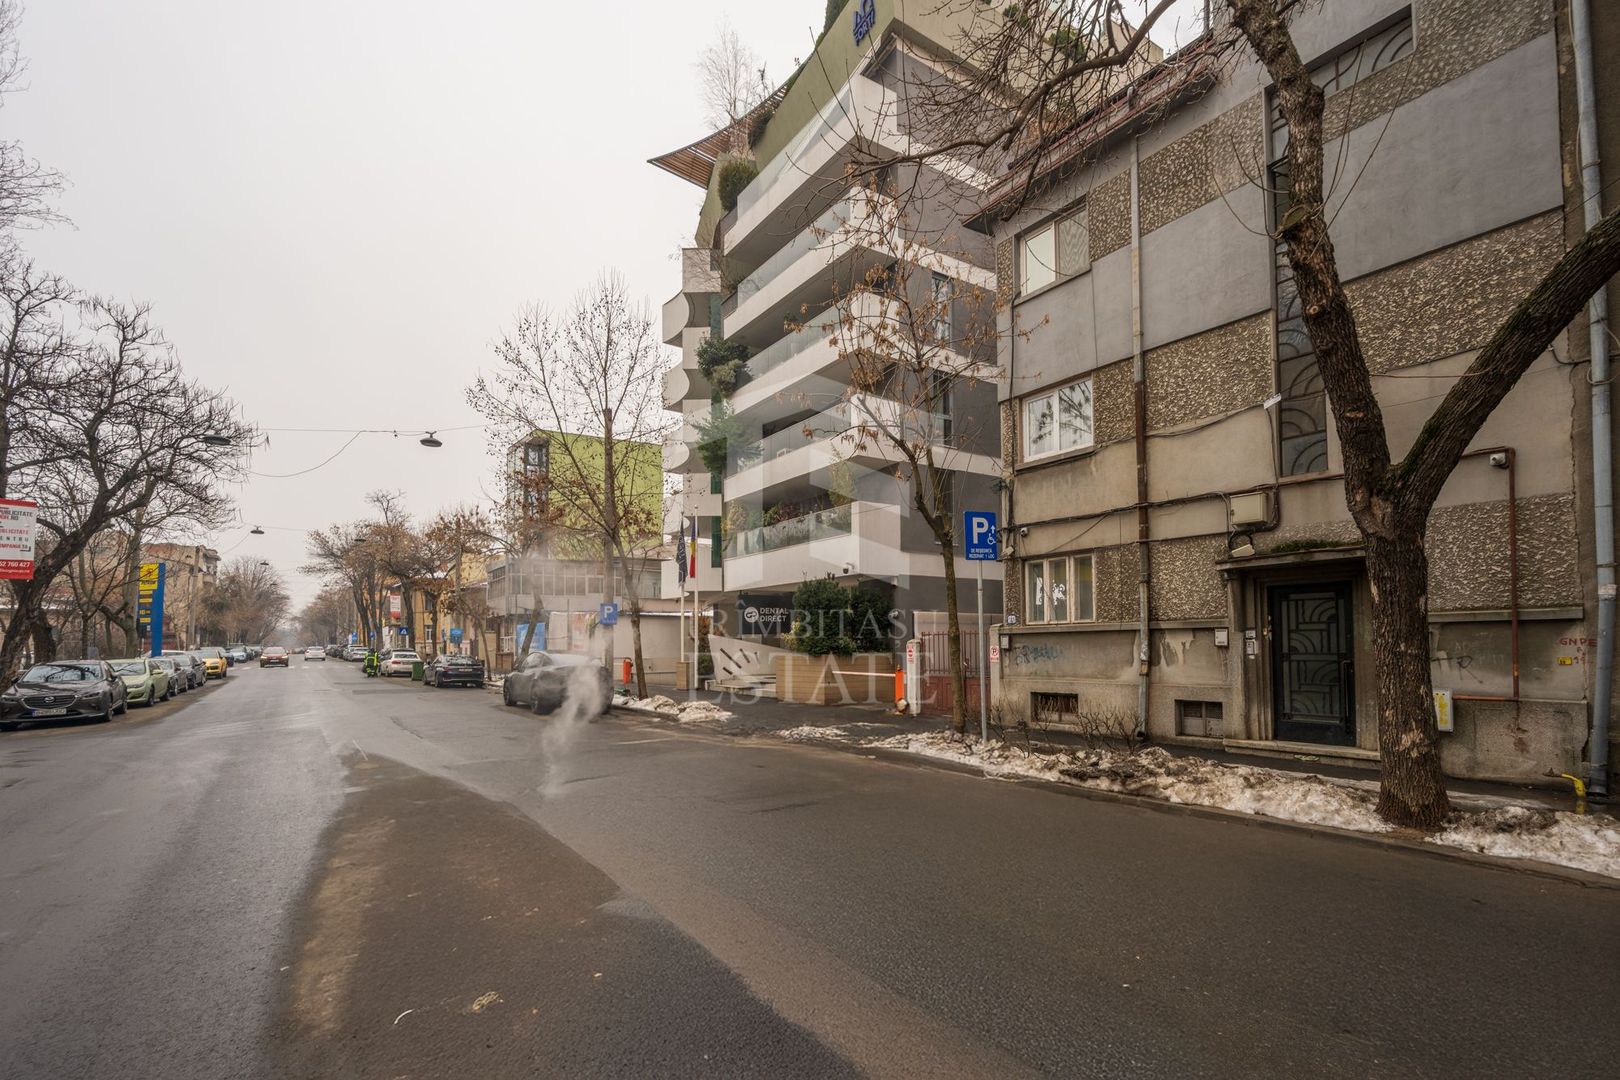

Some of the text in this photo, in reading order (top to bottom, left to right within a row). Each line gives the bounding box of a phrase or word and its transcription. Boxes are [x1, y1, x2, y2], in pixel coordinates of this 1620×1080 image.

[972, 517, 988, 544] P
[604, 606, 613, 618] P
[759, 607, 789, 615] DENTAL
